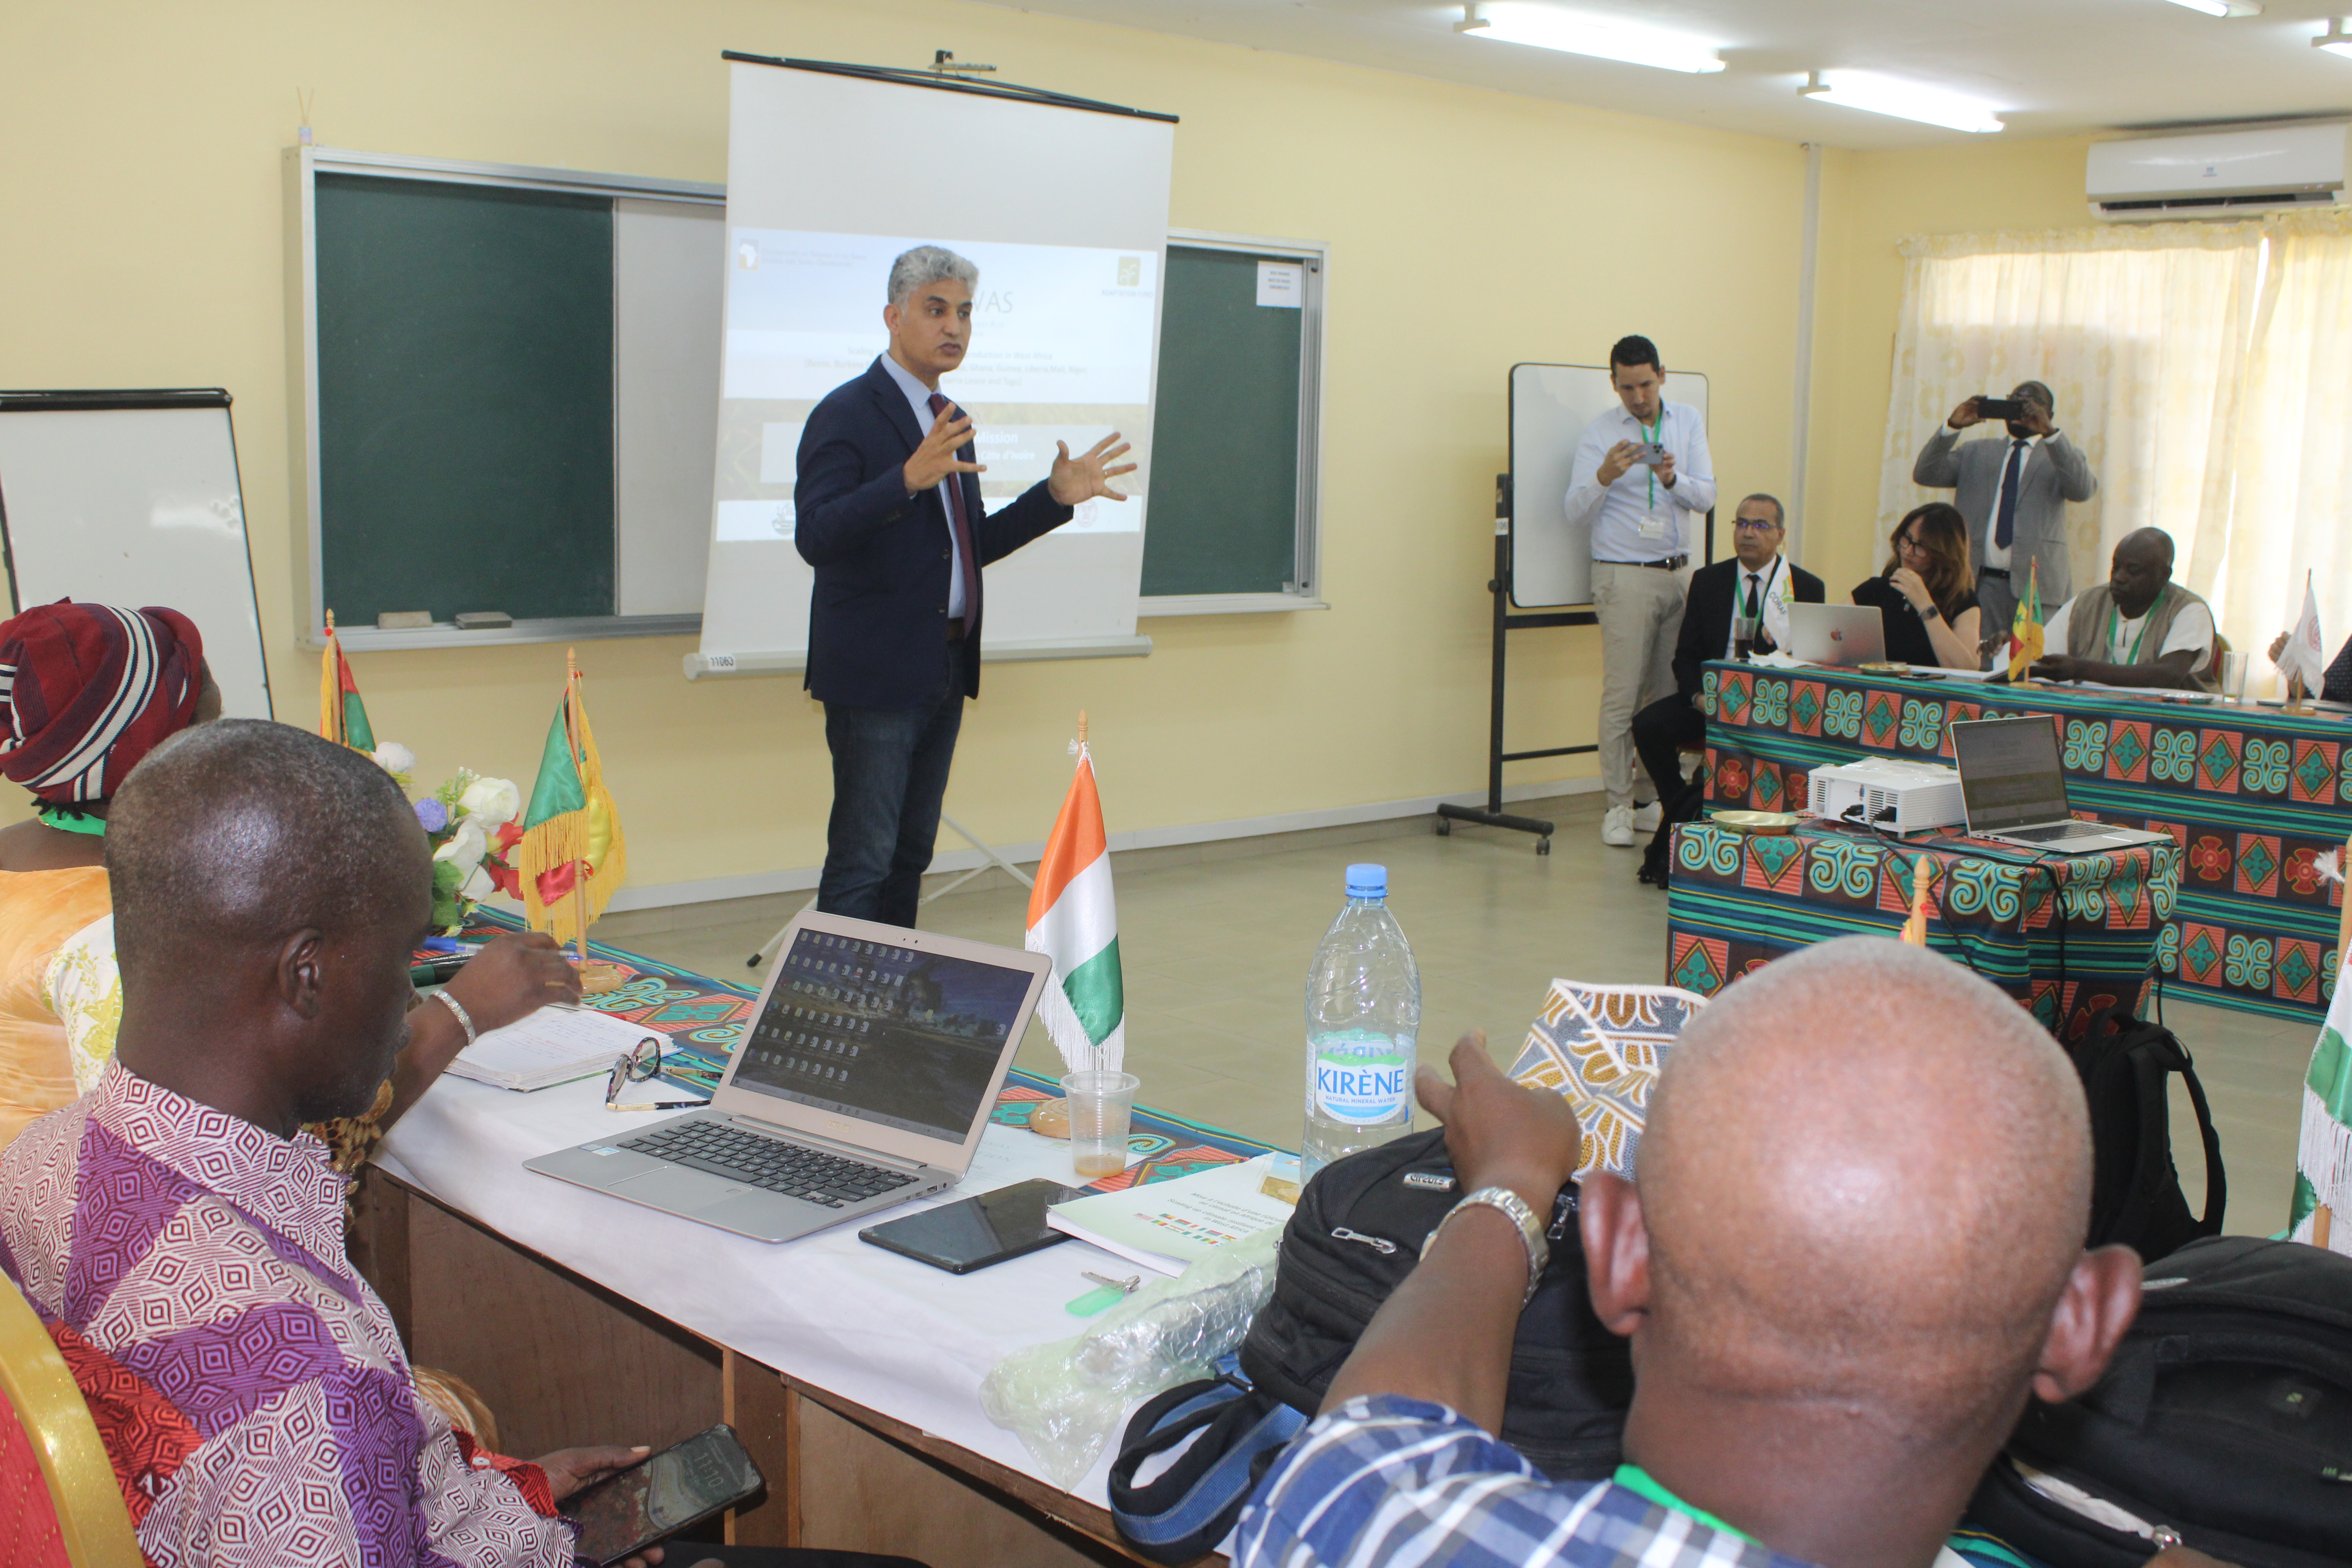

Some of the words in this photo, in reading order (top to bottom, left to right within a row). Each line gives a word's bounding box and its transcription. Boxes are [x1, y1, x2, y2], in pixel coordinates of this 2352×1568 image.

[974, 430, 1019, 444] Mission
[1318, 1067, 1405, 1096] KIRÈNE
[1325, 1095, 1350, 1103] NATURAL
[1167, 1198, 1192, 1209] Scaling
[1202, 1210, 1227, 1221] climate
[1211, 1218, 1230, 1227] West
[1229, 1224, 1249, 1234] Africa
